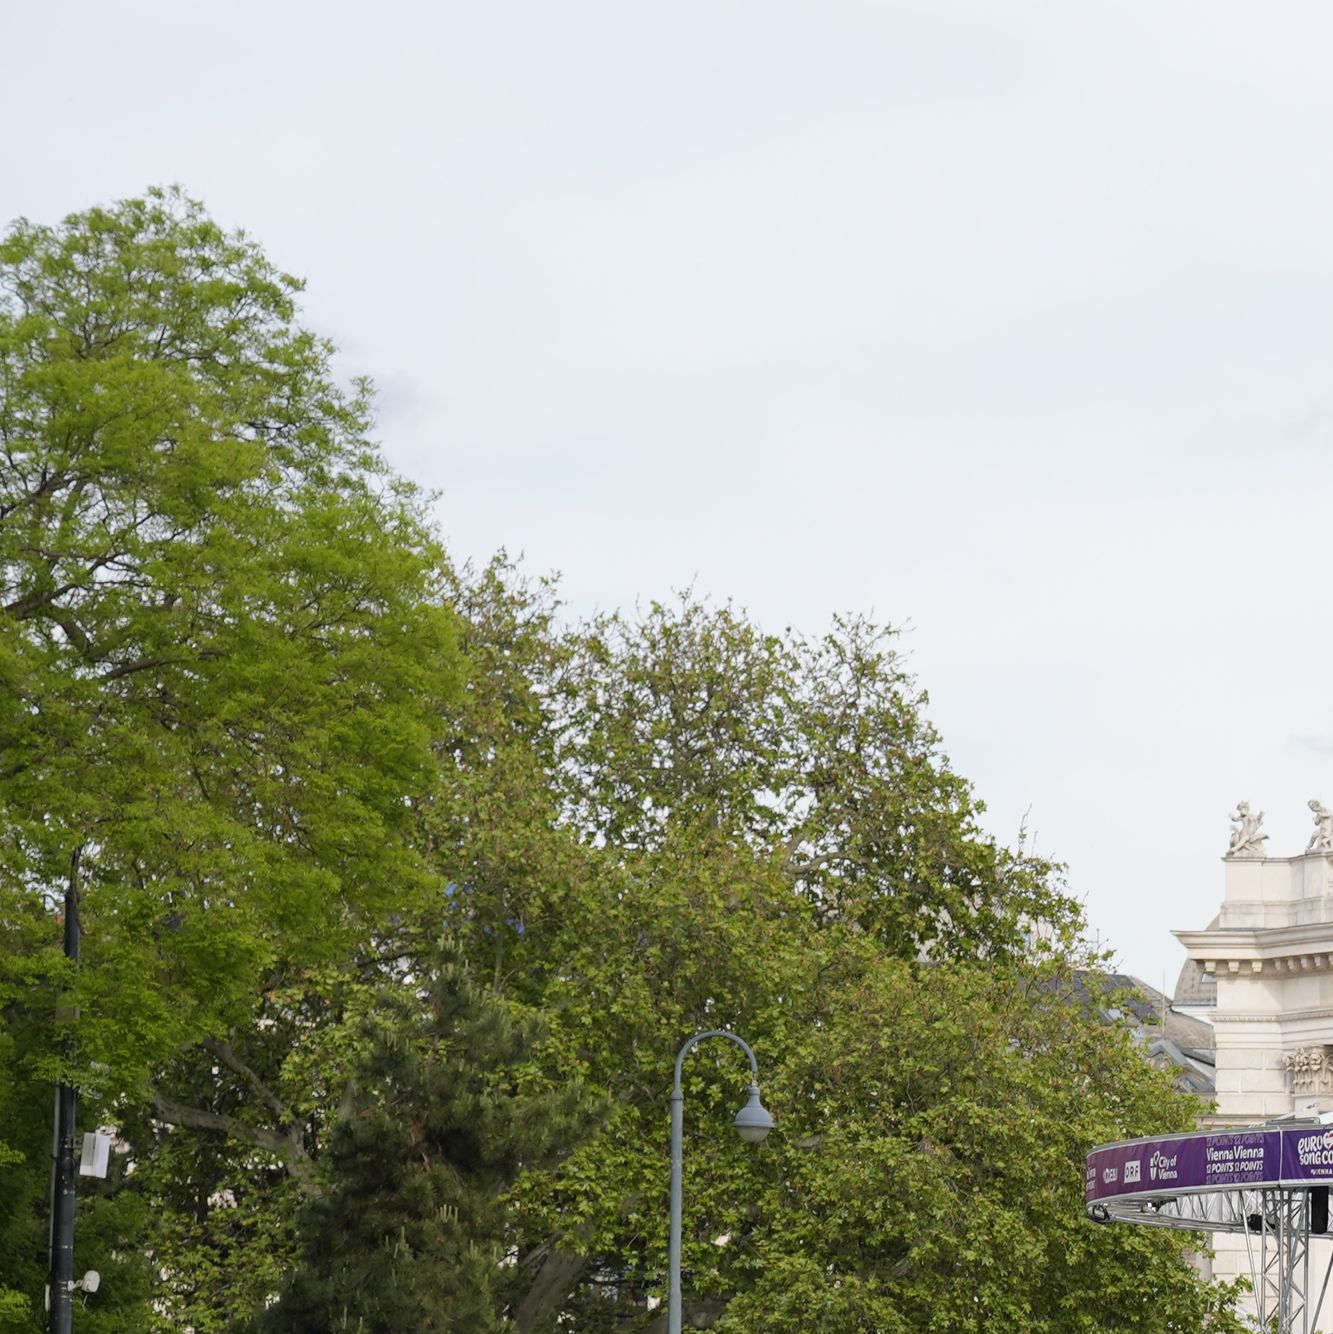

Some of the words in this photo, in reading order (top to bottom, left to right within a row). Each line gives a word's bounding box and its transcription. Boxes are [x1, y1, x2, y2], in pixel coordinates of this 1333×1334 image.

[1206, 1147, 1234, 1162] Vienna
[1233, 1145, 1264, 1160] Vienna
[1299, 1152, 1321, 1166] SONG
[1158, 1155, 1170, 1169] City
[1169, 1154, 1178, 1167] of
[1211, 1162, 1234, 1173] POINTS
[1239, 1160, 1264, 1171] POINTS
[1158, 1168, 1178, 1180] Vienna
